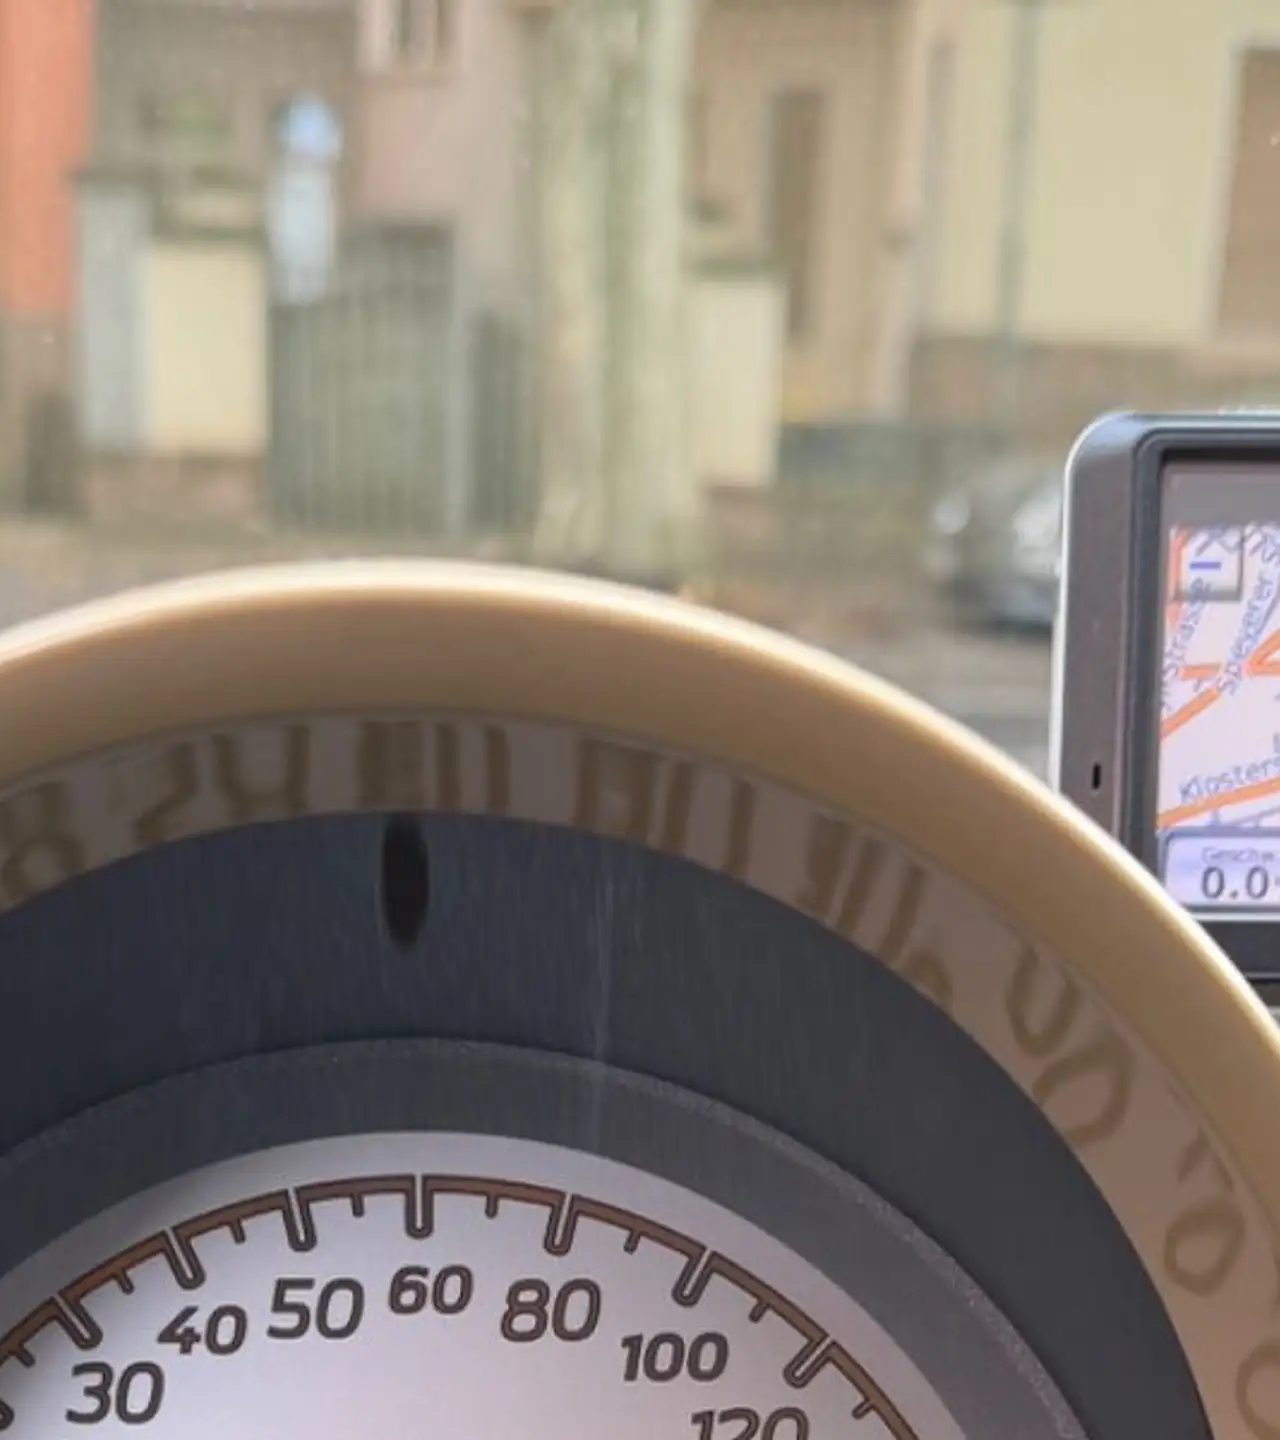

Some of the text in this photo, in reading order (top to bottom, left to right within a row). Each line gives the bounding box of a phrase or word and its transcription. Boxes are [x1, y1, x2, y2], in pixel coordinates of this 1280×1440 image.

[1202, 866, 1268, 899] 0.0
[267, 1277, 365, 1339] 50
[387, 1264, 474, 1315] 60
[499, 1278, 602, 1342] 80
[157, 1305, 248, 1355] 40
[620, 1332, 728, 1383] 100
[65, 1362, 165, 1425] 30
